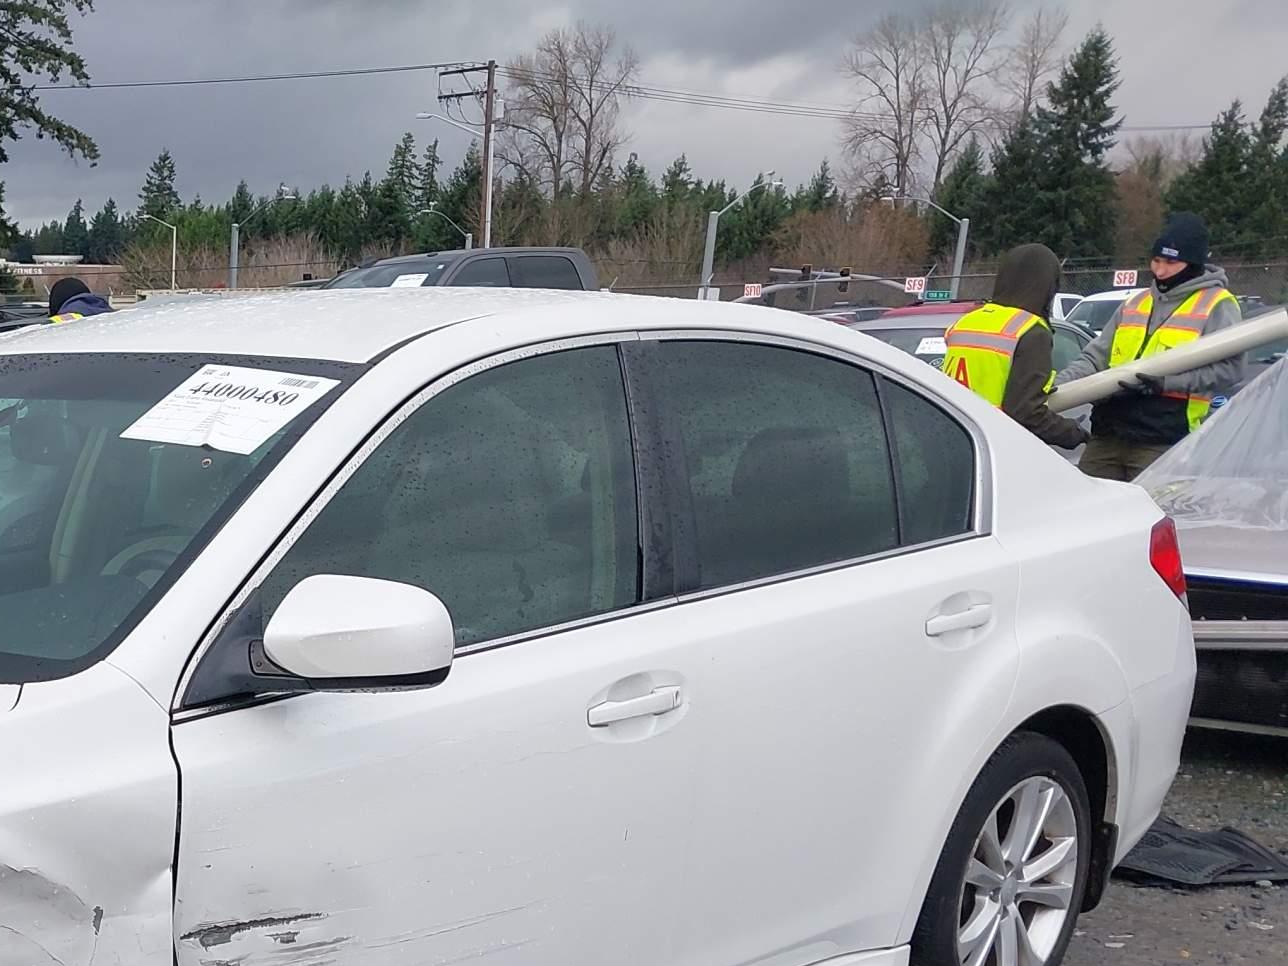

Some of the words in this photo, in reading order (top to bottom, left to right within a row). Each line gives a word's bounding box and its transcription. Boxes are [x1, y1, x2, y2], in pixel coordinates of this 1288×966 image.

[1115, 271, 1135, 285] SF8
[745, 285, 761, 297] SF10
[906, 279, 924, 291] SF9
[189, 382, 300, 407] 44000480
